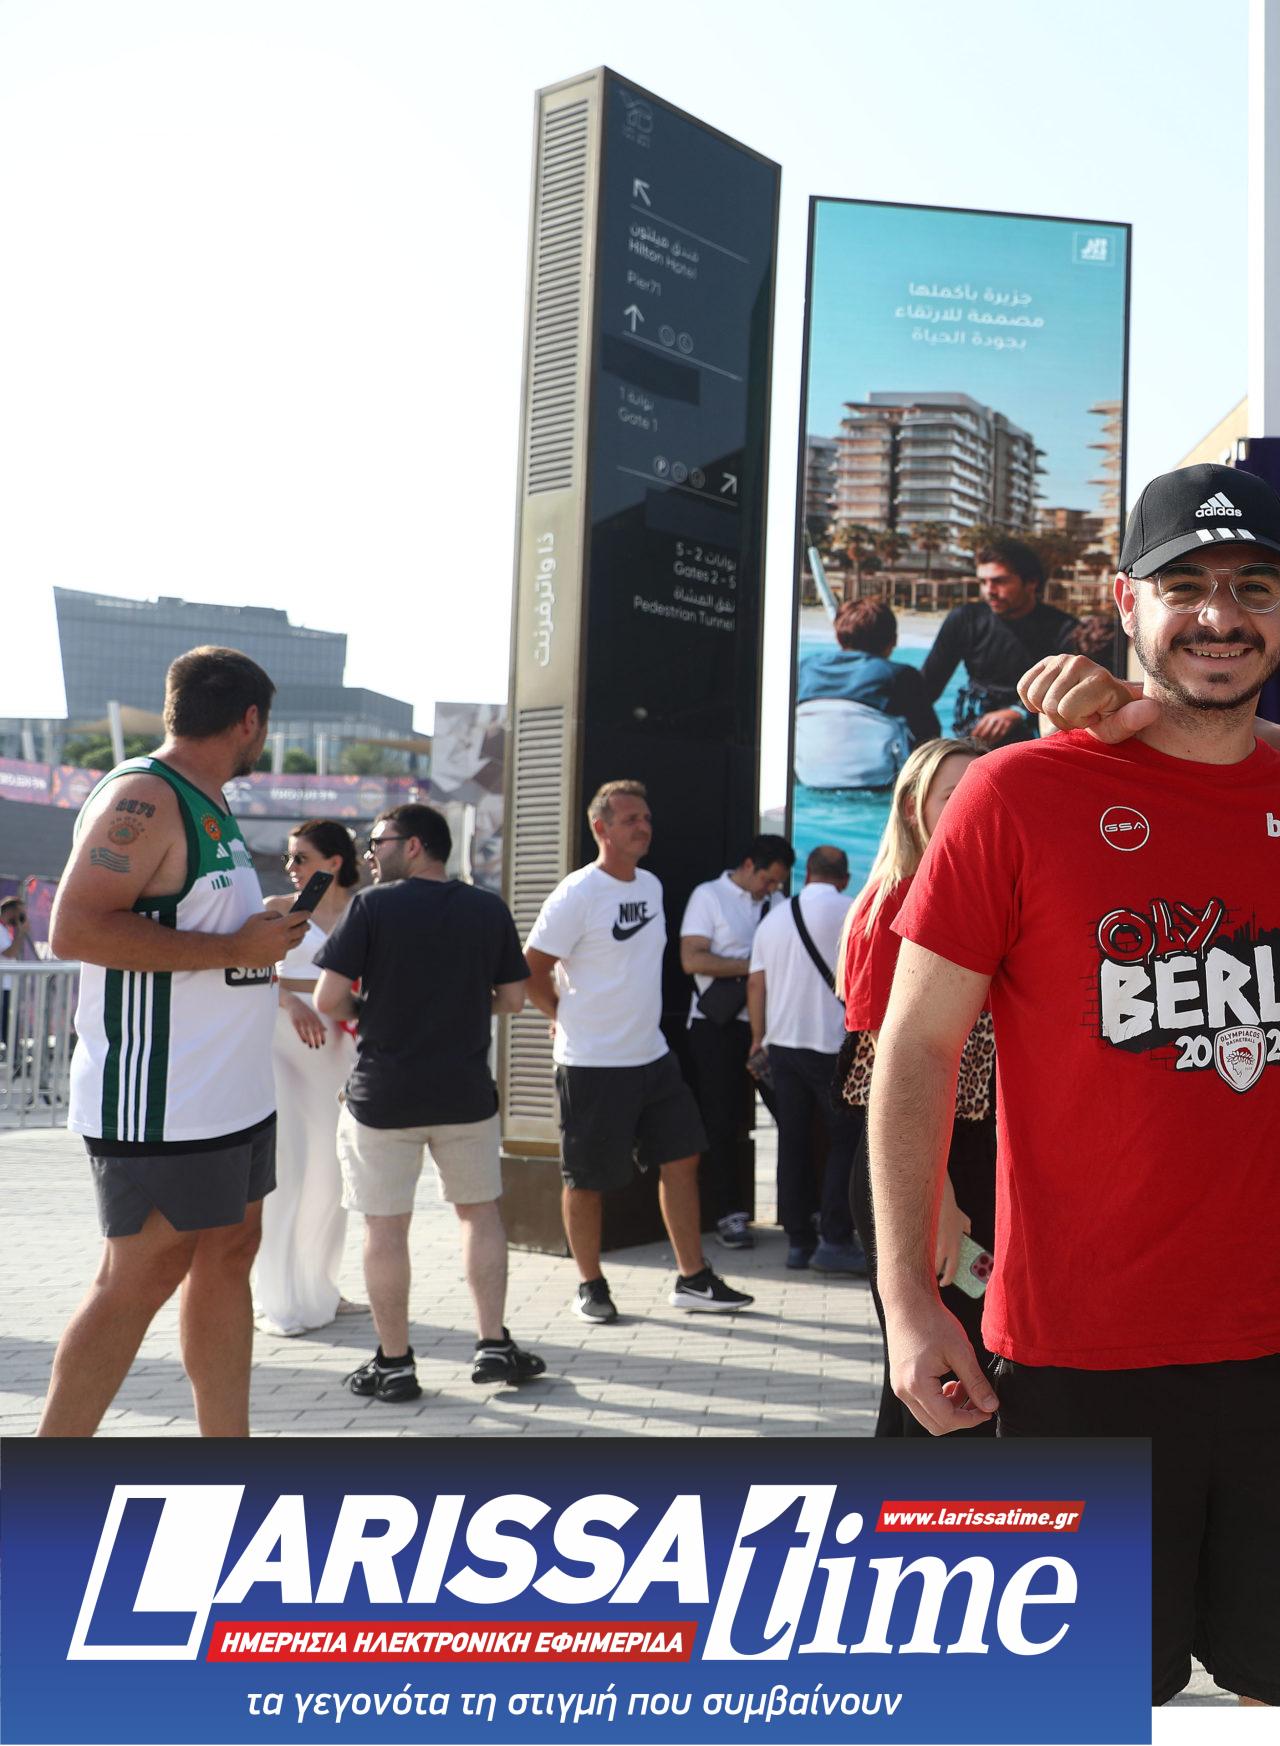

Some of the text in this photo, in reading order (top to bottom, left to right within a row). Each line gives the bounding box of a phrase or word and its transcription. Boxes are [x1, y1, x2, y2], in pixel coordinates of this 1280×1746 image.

[629, 238, 698, 280] Hilton Hotel
[983, 286, 1033, 306] جزيرة
[894, 304, 1045, 328] مصممة للارتقاء
[911, 326, 1027, 351] بجودة الحياة
[618, 406, 658, 432] Gate 1
[1195, 506, 1243, 518] adidas
[675, 541, 685, 557] 5
[673, 560, 709, 583] Gates
[710, 569, 719, 585] 2
[534, 556, 557, 667] واترفرنت
[633, 595, 735, 632] Pedestrian Tunnel
[1104, 822, 1146, 832] GSA
[619, 901, 649, 923] NIKE
[1220, 1030, 1261, 1043] OLYMPIACOS
[1226, 1037, 1255, 1046] BASKETBALL
[1174, 1034, 1214, 1070] 20
